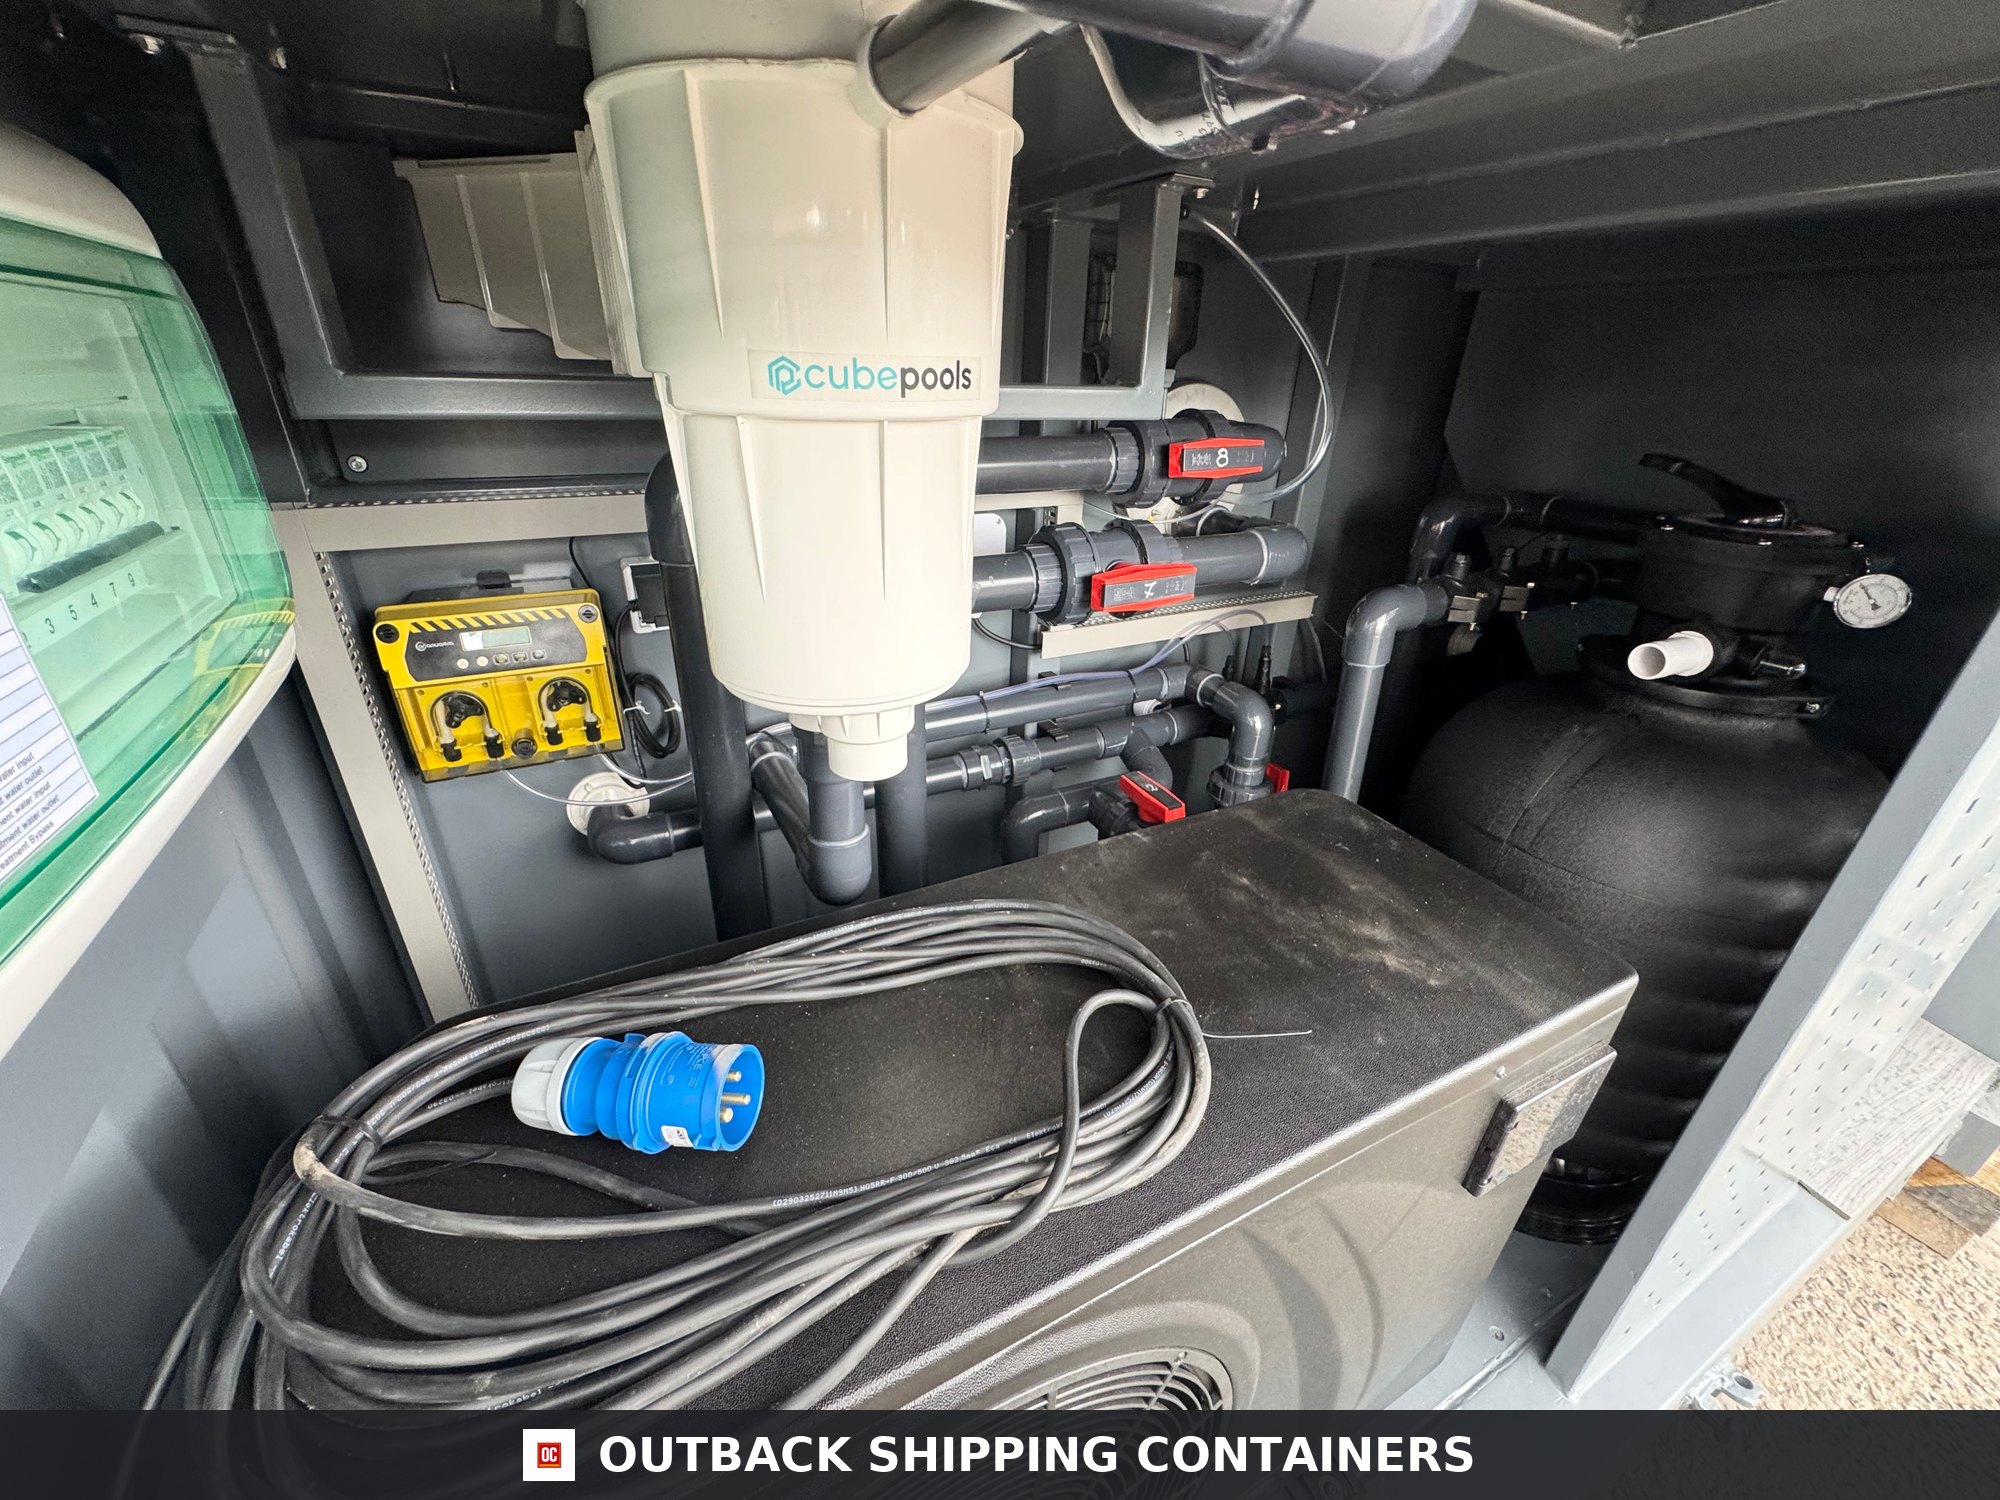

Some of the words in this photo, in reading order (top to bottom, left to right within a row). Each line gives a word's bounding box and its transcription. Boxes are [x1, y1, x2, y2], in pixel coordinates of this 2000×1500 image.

[804, 357, 972, 398] cubepools
[1216, 448, 1229, 468] 8
[45, 617, 55, 634] 3
[68, 604, 78, 621] 5
[90, 592, 99, 608] 4
[109, 582, 118, 597] 7
[127, 572, 136, 587] 9
[16, 752, 35, 771] input
[5, 783, 24, 801] water
[25, 765, 44, 784] outlet
[15, 798, 32, 814] water
[34, 781, 51, 799] input
[22, 812, 40, 829] water
[41, 795, 60, 813] outlet
[0, 841, 28, 870] eatment
